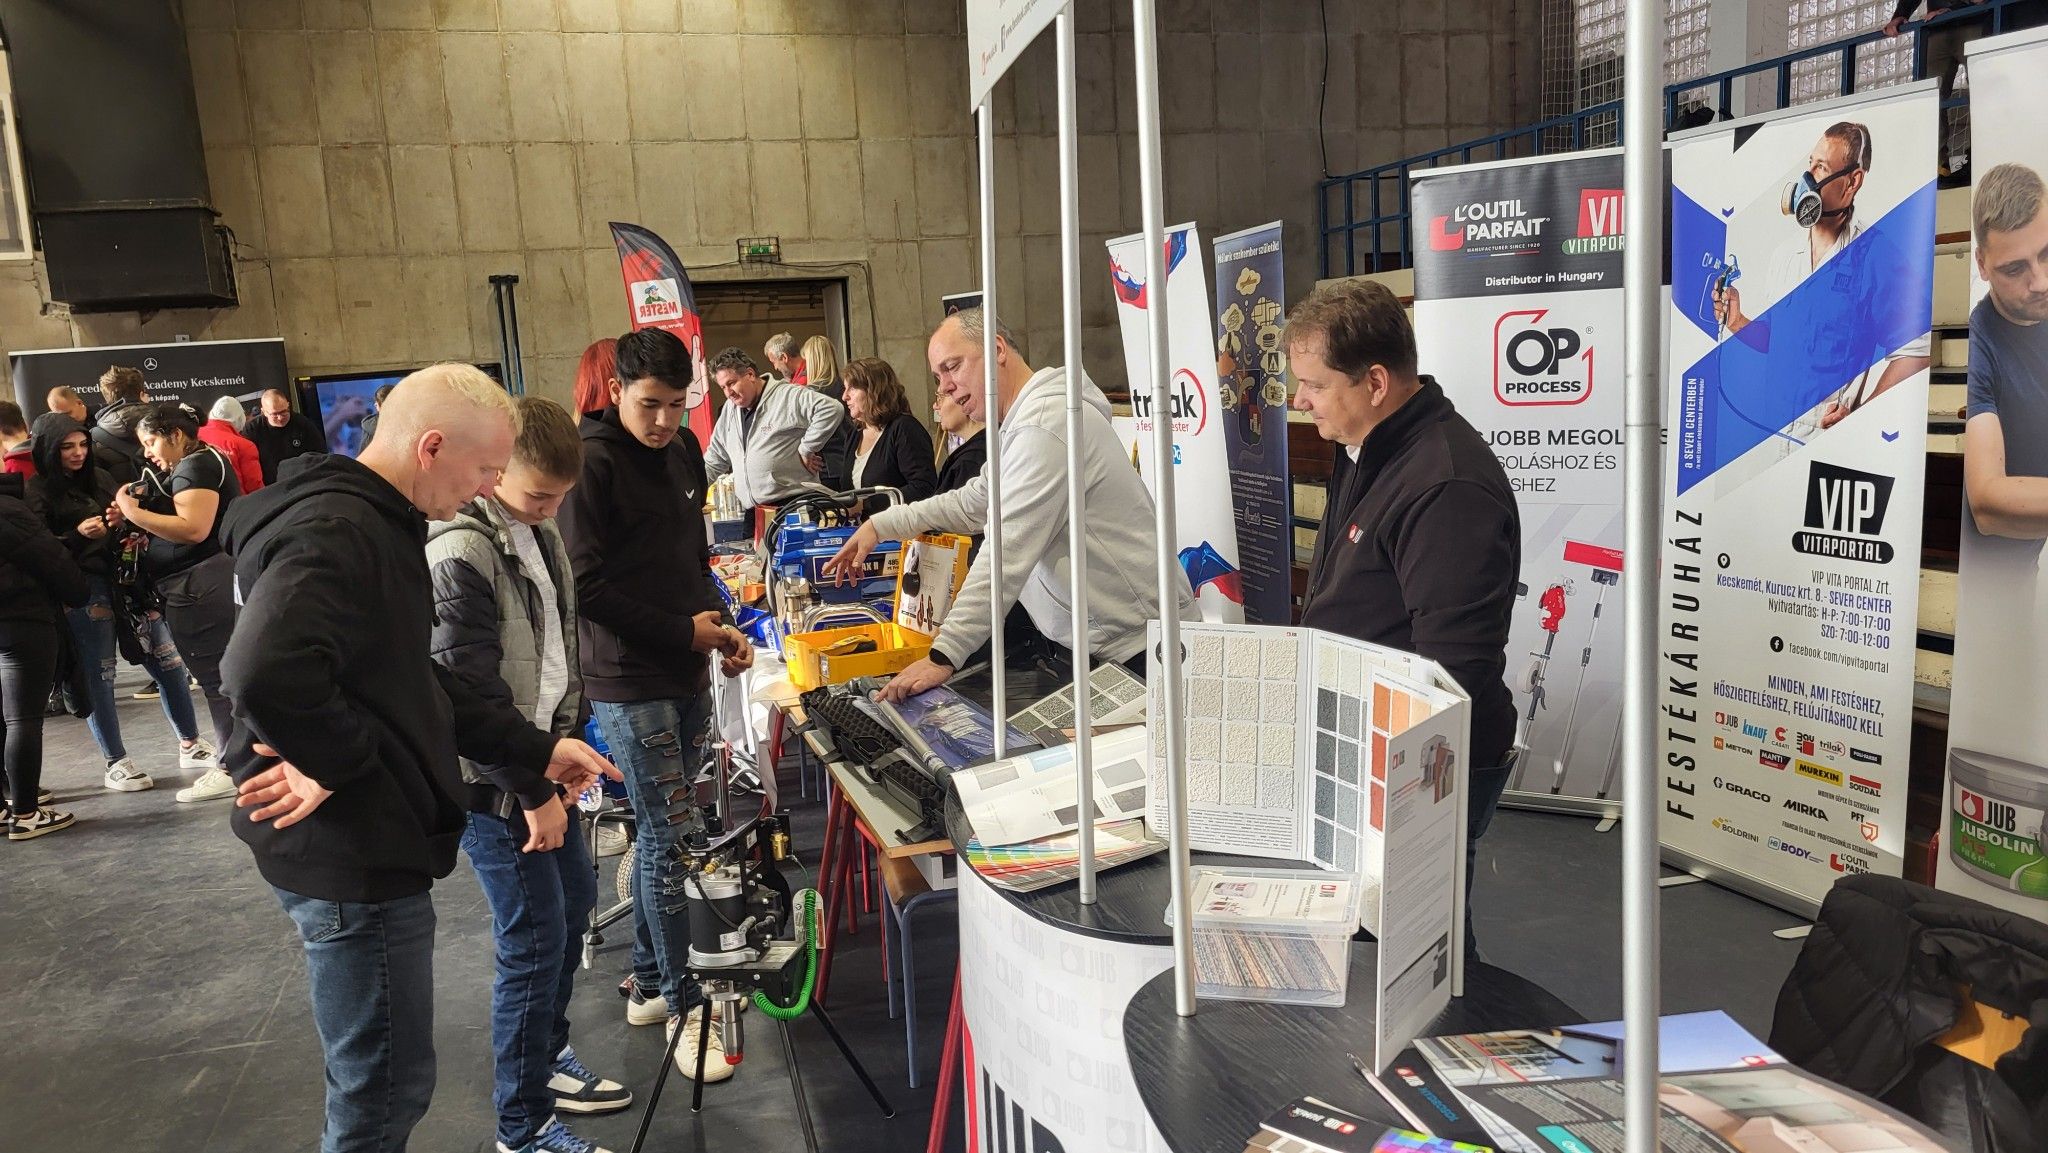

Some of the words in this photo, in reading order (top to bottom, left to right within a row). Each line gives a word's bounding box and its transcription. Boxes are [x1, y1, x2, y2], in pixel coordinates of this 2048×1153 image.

[1454, 199, 1527, 223] L'OUTIL
[1588, 195, 1625, 237] VI
[1466, 218, 1546, 241] PARFAIT
[1467, 244, 1508, 253] MANUFACTURER
[1568, 235, 1625, 253] VITAPOR
[1485, 276, 1542, 287] Distributor
[1545, 275, 1555, 283] in
[1558, 271, 1604, 284] Hungary
[1506, 328, 1581, 376] OP
[67, 384, 100, 395] erced
[143, 379, 188, 394] Academy
[191, 376, 245, 387] Kecskemét
[1505, 381, 1581, 394] PROCESS
[155, 394, 180, 402] képzés
[1133, 381, 1198, 418] trak
[1686, 378, 1697, 429] CENTERBEN
[1487, 430, 1541, 446] JOBB
[1547, 429, 1625, 445] MEGOL
[1684, 432, 1694, 460] SEVER
[1496, 451, 1589, 470] SOLÁSHOZ
[1594, 451, 1617, 470] ÉS
[1509, 477, 1556, 492] SHEZ
[1819, 477, 1876, 533] VIP
[1802, 534, 1882, 562] VITAPORTAL
[862, 562, 873, 571] AX
[1716, 573, 1764, 594] Kecskemét,
[1765, 580, 1796, 598] Kurucz
[1798, 585, 1811, 600] krt.
[1829, 591, 1854, 608] SEVER
[1856, 595, 1892, 614] CENTER
[1811, 570, 1825, 584] VIP
[1826, 571, 1842, 586] VITA
[1845, 575, 1872, 593] PORTAL
[1876, 580, 1892, 595] Zrt.
[1768, 598, 1819, 619] Nyitvatartás:
[1821, 607, 1839, 621] H-P:
[1841, 610, 1891, 632] 7:00-17:00
[1821, 624, 1838, 639] SZO:
[1840, 627, 1890, 650] 7:00-12:00
[1662, 509, 1703, 821] FESTÉKÁRUHÁZ
[1789, 642, 1889, 673] facebook.com/vipvitaportal
[1768, 675, 1808, 700] MINDEN,
[1810, 684, 1829, 702] AMI
[1831, 687, 1885, 718] FESTÉSHEZ,
[1713, 680, 1791, 715] HŐSZIGETELÉSHEZ,
[1793, 701, 1858, 731] FELÚJÍTÁSHOZ
[1859, 718, 1884, 738] KELL
[1726, 714, 1739, 728] JUB
[1725, 743, 1753, 756] METON
[1820, 740, 1843, 753] trilak
[1799, 764, 1840, 782] MUREXIN
[1725, 782, 1771, 803] GRACO
[1849, 782, 1881, 798] SOUDAL
[1783, 799, 1829, 822] MIRKA
[1851, 811, 1865, 823] PFT
[1985, 801, 2016, 832] JUB
[1721, 824, 1759, 843] BOLDRINI
[1960, 820, 2034, 856] JUBOLIN
[1780, 842, 1811, 859] BODY
[1840, 853, 1870, 869] L'OUTIL
